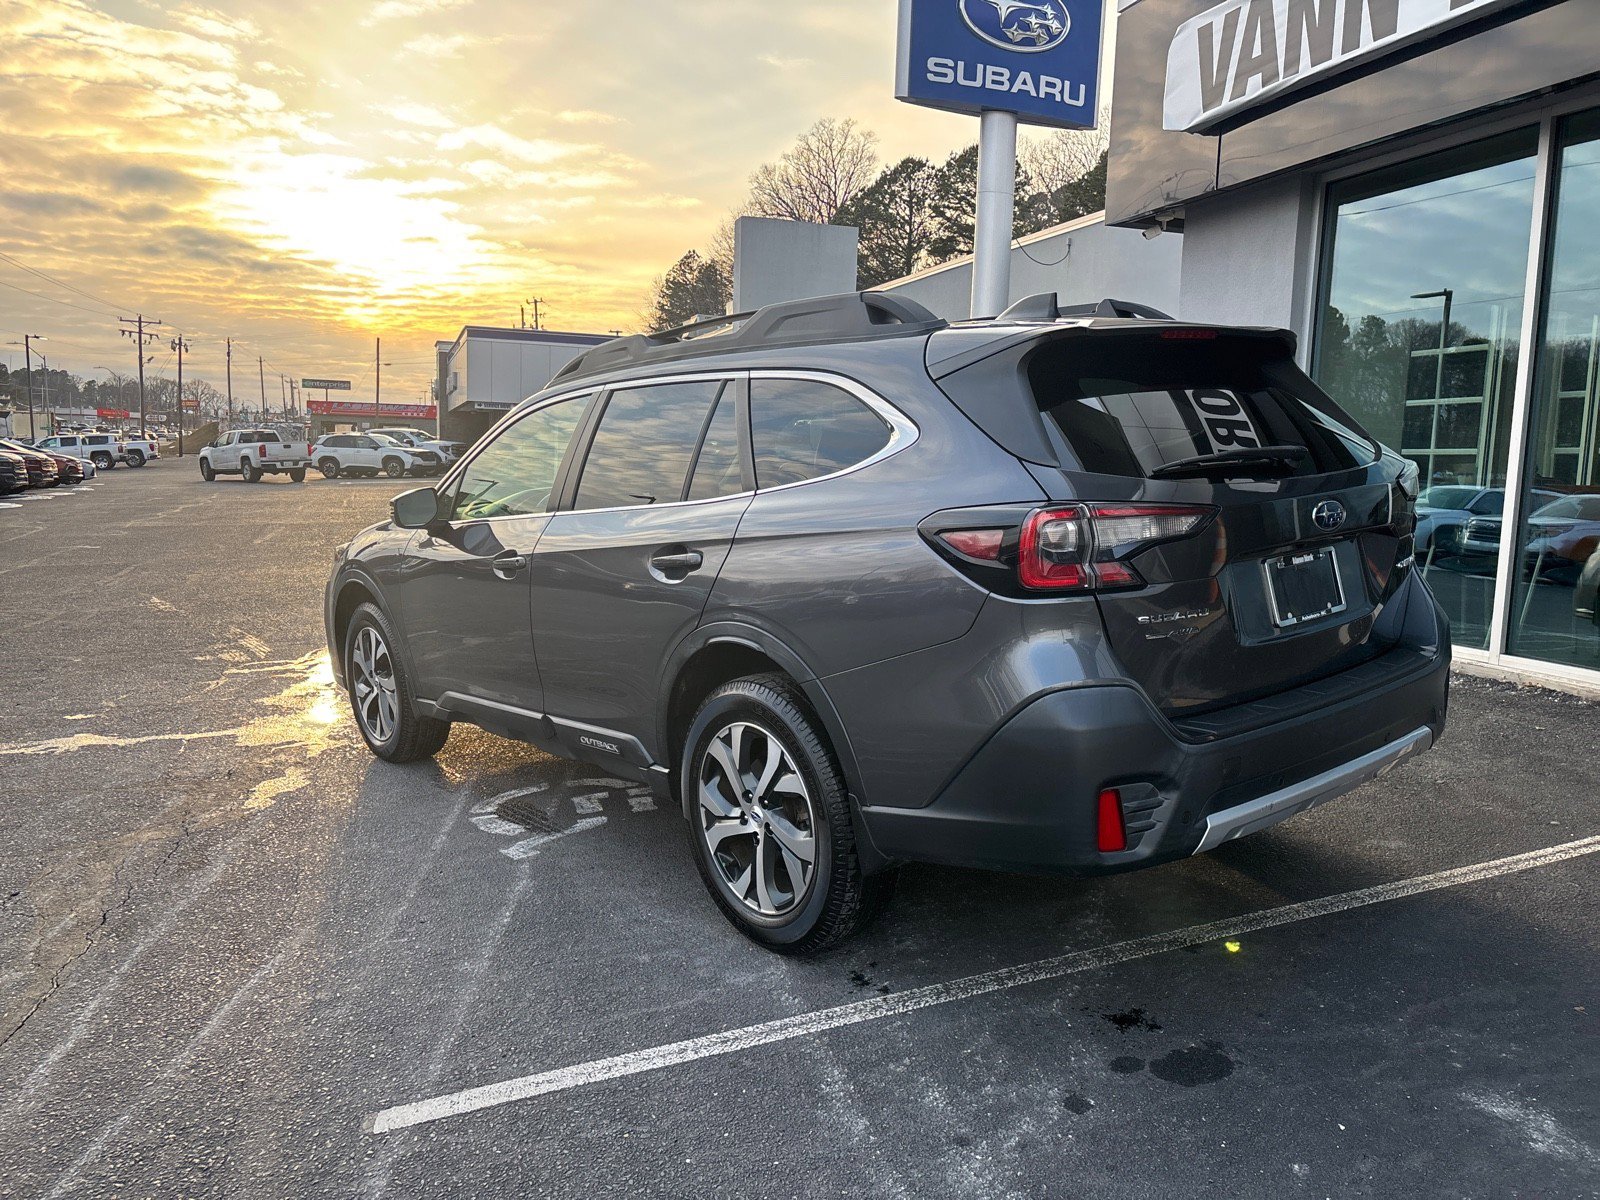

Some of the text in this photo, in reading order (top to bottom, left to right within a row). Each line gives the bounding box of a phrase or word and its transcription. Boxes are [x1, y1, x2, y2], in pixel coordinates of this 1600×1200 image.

[926, 56, 1086, 107] SUBARU
[304, 380, 350, 389] enterprise
[1137, 609, 1209, 625] SUBARU
[580, 736, 619, 753] OUTBACK
